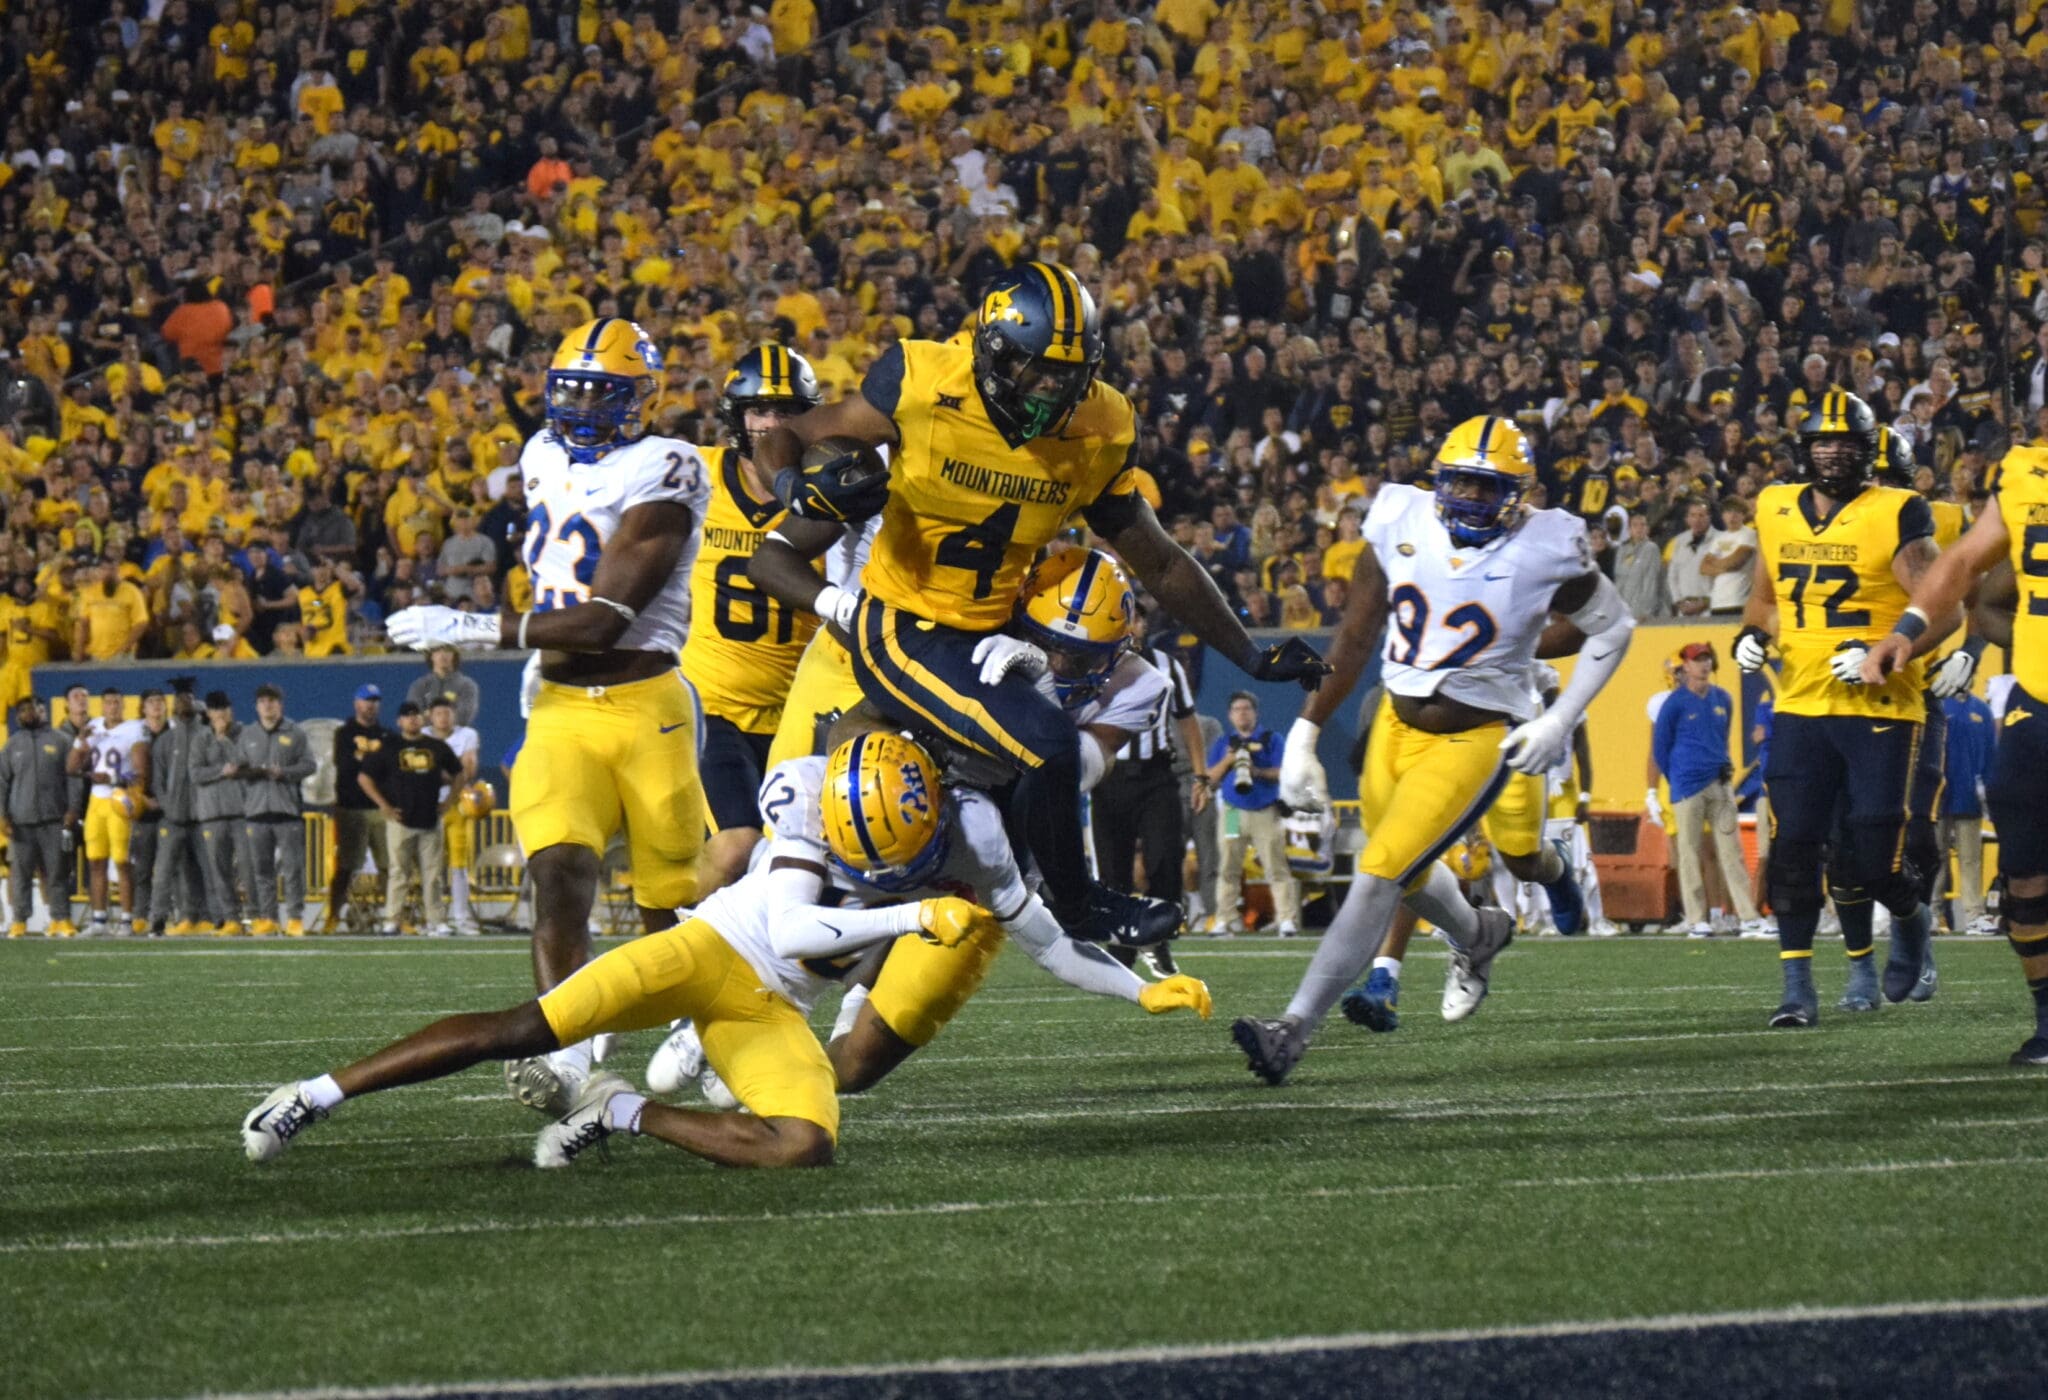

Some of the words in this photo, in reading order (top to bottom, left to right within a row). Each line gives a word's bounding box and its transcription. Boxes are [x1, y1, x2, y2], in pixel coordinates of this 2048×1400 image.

[662, 451, 702, 493] 23
[940, 458, 1071, 505] MOUNTAINEERS
[936, 503, 1021, 600] 4
[1780, 543, 1858, 562] MOUNTAINEERS
[1777, 562, 1871, 628] 72
[1390, 582, 1499, 671] 92
[759, 771, 796, 822] 12
[899, 762, 931, 825] Pitt
